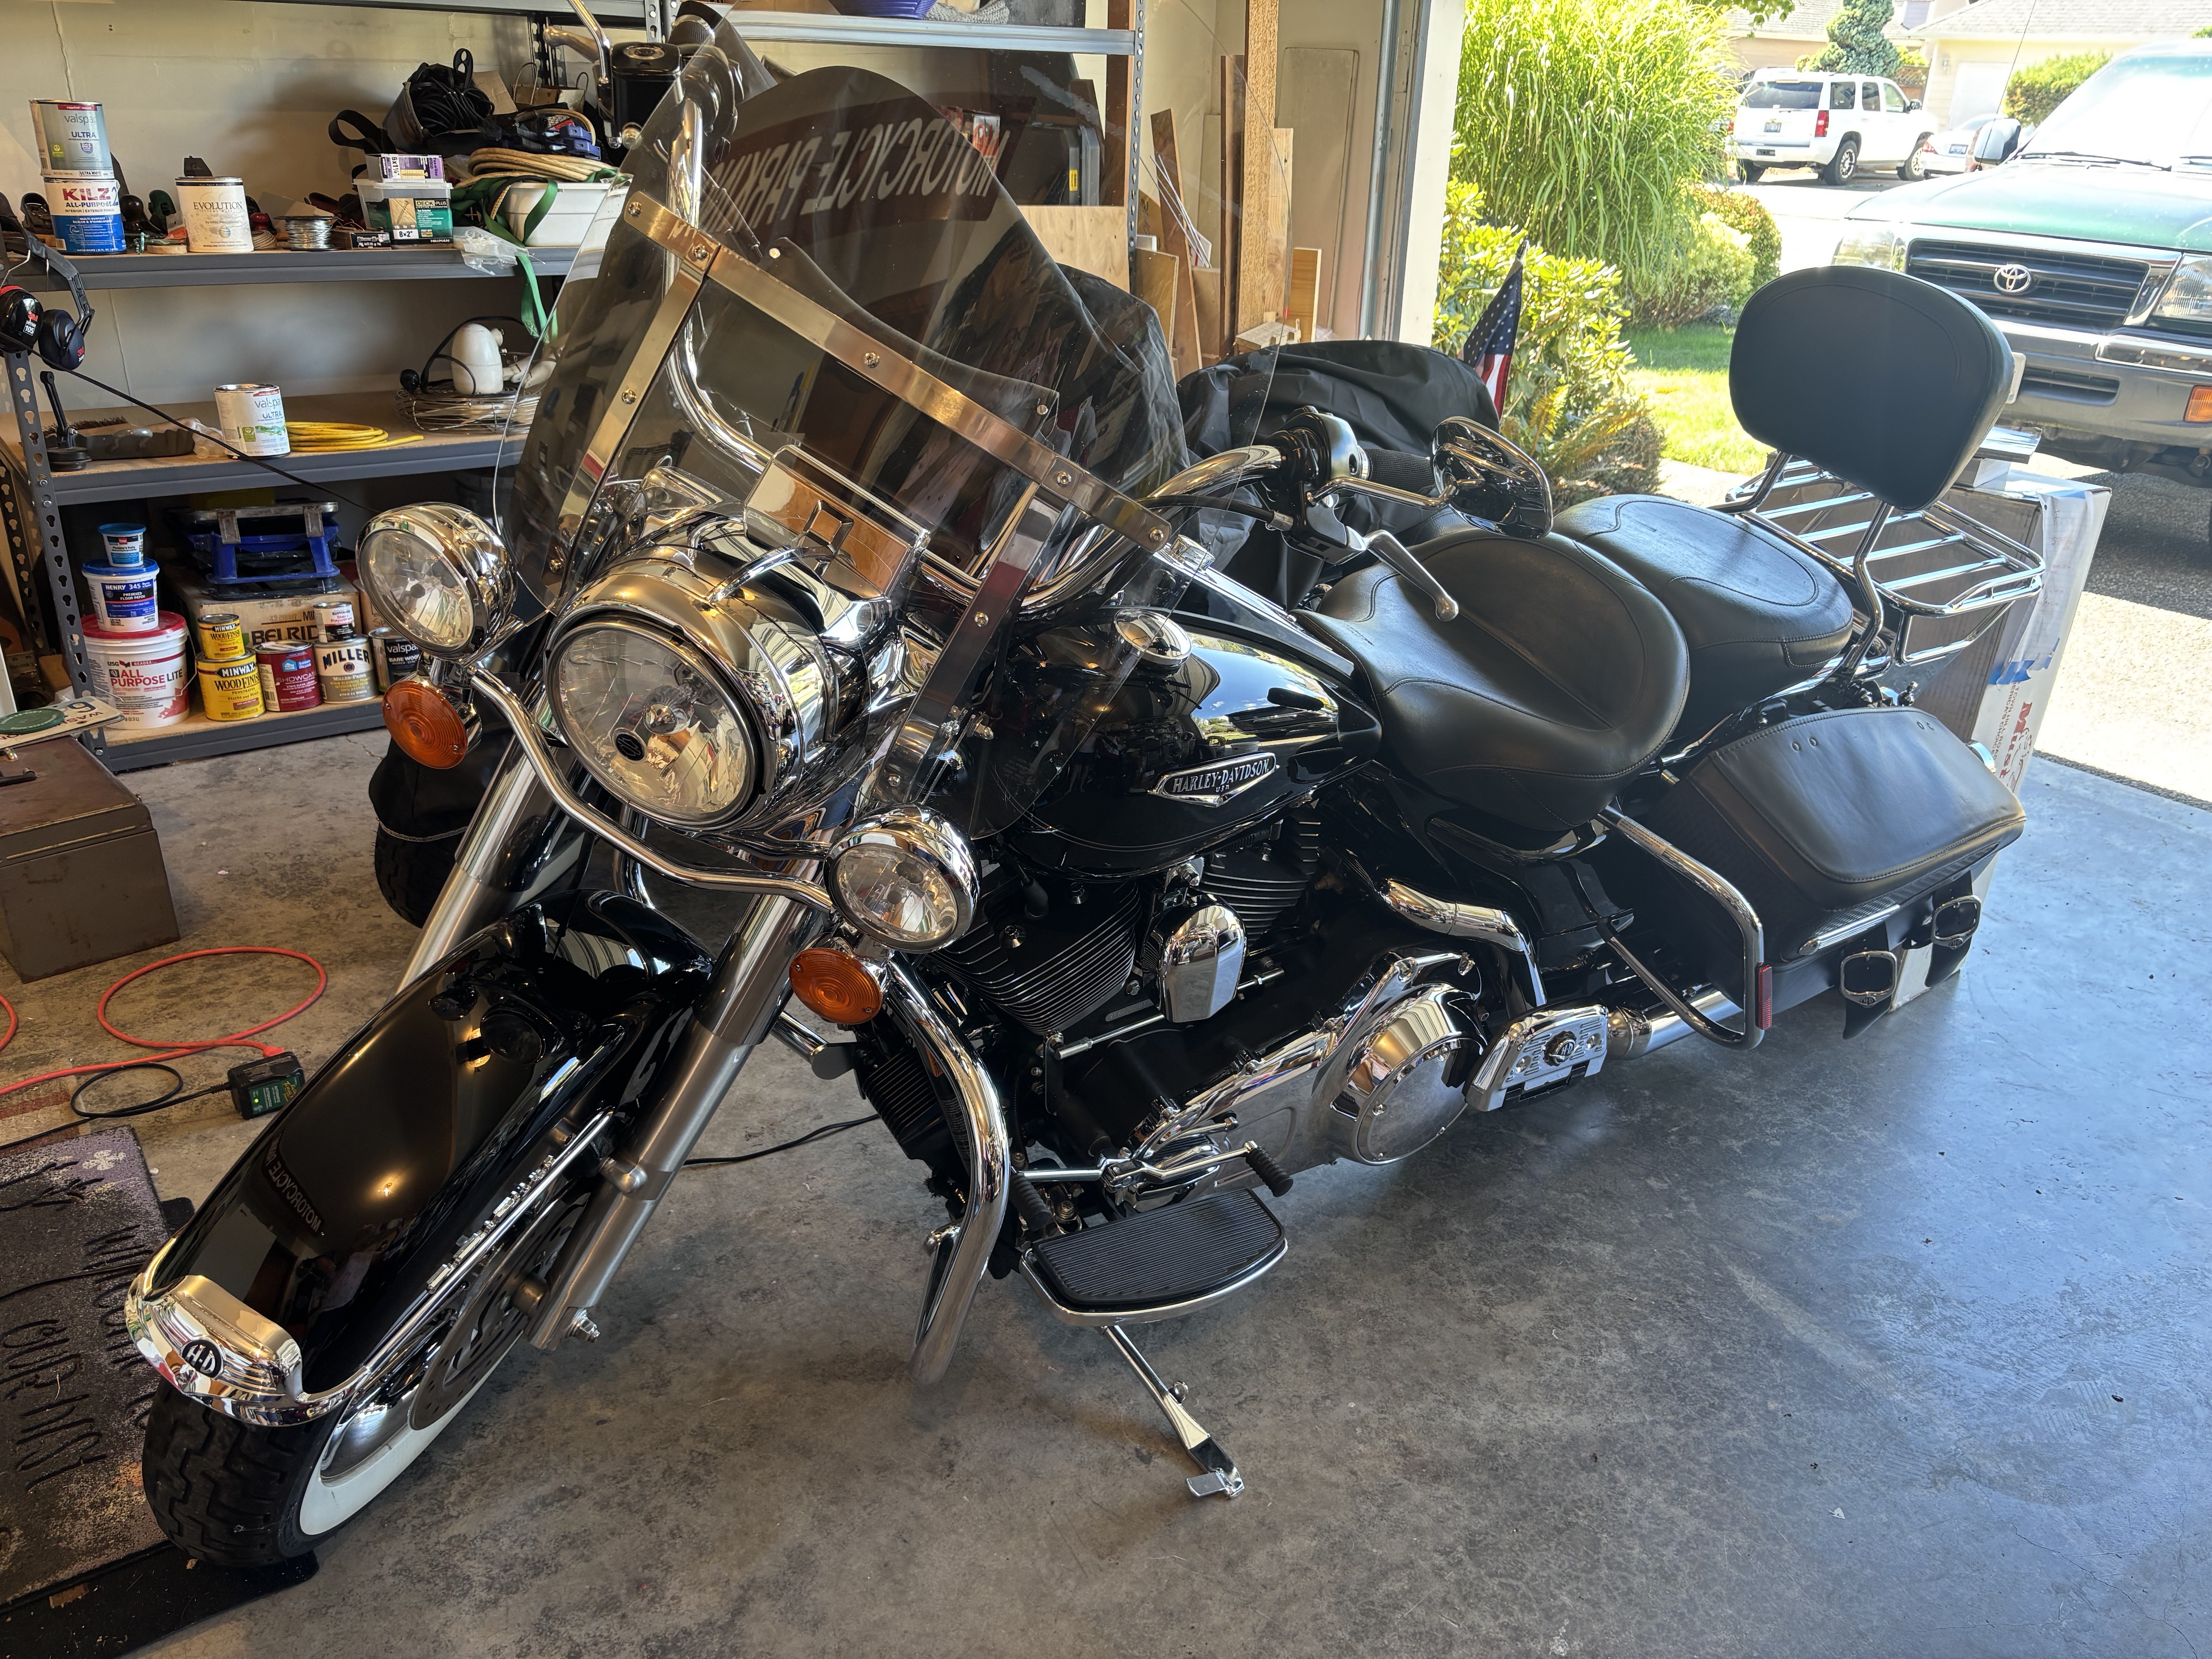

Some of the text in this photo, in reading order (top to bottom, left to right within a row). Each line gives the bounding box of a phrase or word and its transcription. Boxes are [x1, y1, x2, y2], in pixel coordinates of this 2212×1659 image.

[62, 186, 119, 206] KILZ 2
[25, 325, 35, 334] 105
[211, 632, 227, 640] WOOD
[323, 649, 370, 670] MILLER
[121, 670, 144, 678] ALL
[167, 669, 182, 682] LITE
[222, 663, 255, 677] MINWAX
[110, 675, 165, 687] PURPOSE
[215, 679, 241, 691] WOOD
[1172, 758, 1270, 793] HARLEY-DAVIDSON
[1216, 785, 1230, 793] USA
[185, 1345, 216, 1374] H-D
